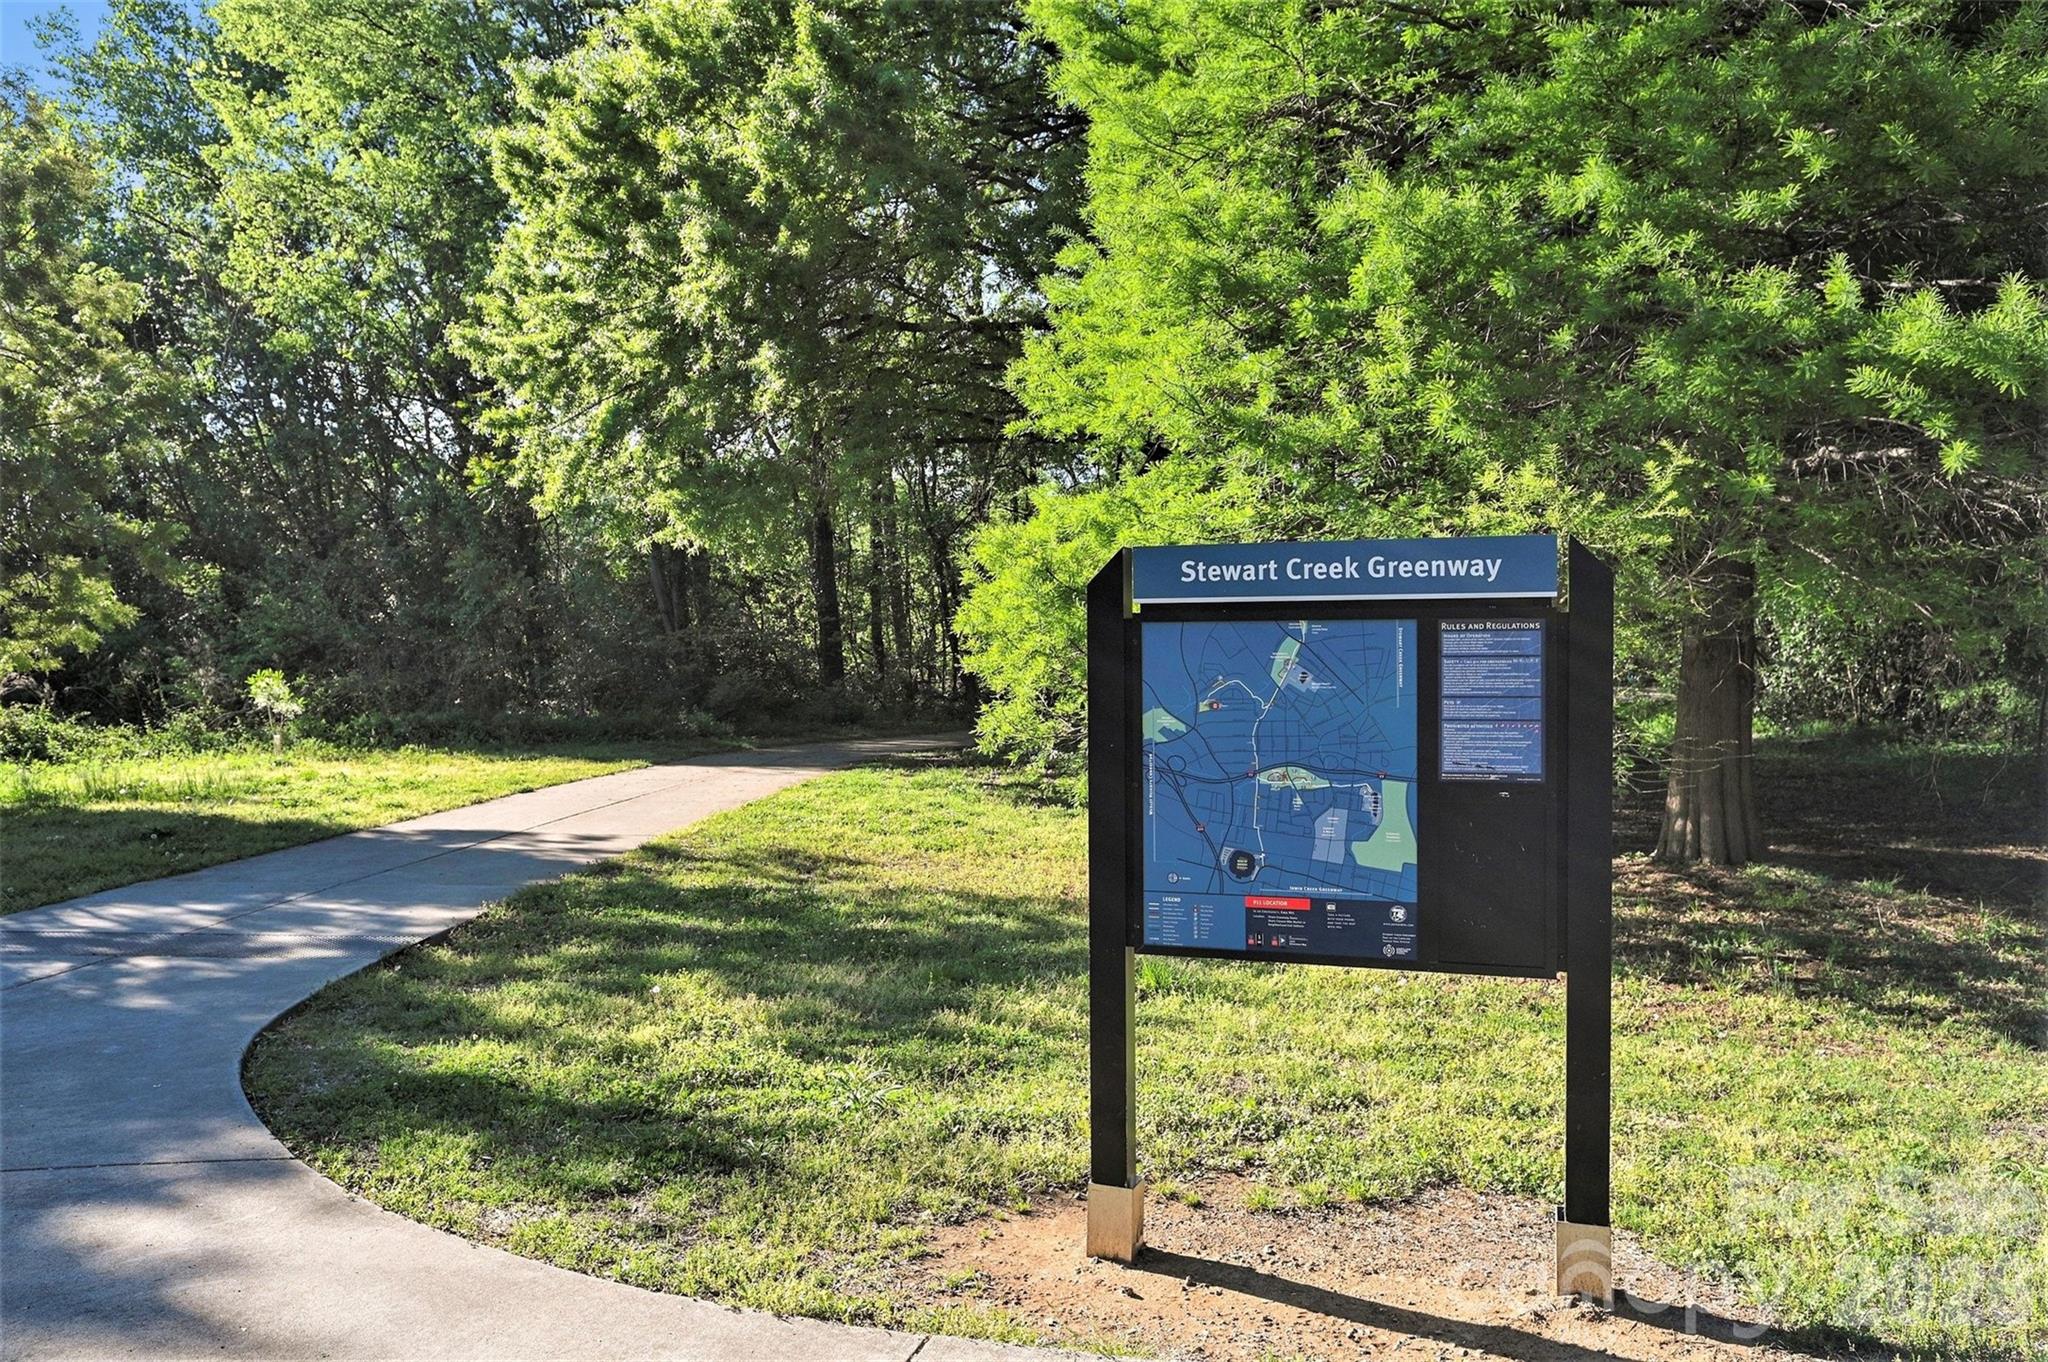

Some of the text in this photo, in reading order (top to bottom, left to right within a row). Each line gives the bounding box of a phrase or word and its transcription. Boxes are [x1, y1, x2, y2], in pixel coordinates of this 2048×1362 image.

[1181, 555, 1502, 583] Stewart Creek Greenway
[1441, 622, 1541, 630] RULES AND REGULATIONS
